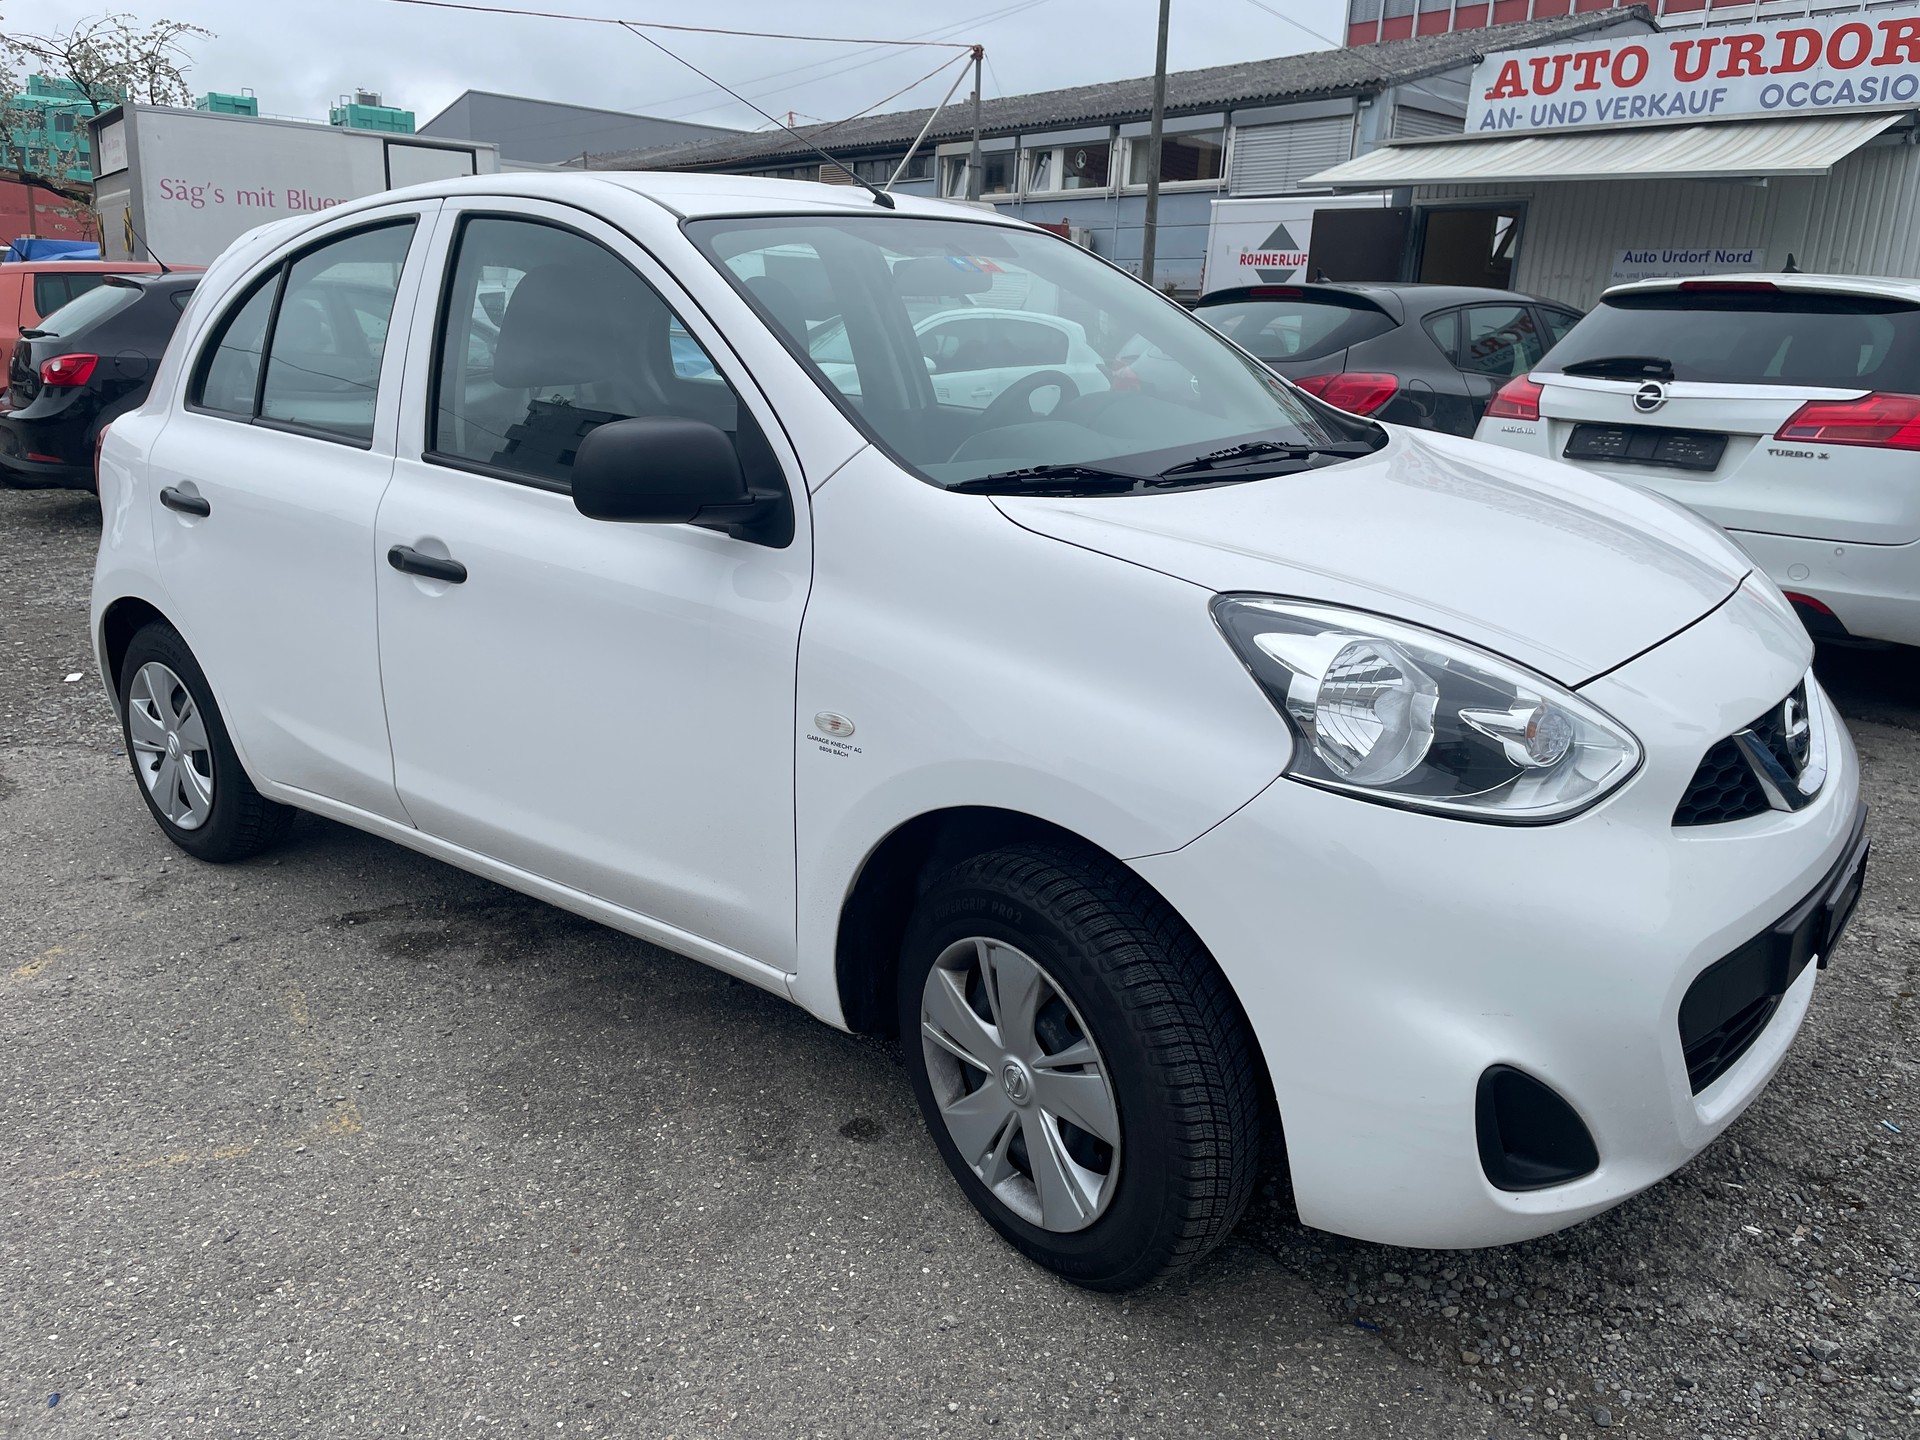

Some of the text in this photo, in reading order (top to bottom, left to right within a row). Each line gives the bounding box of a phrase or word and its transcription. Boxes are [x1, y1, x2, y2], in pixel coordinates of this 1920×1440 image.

[1484, 45, 1649, 100] AUTO
[1480, 107, 1523, 130] AN-
[1530, 101, 1587, 126] UND
[1596, 88, 1728, 120] VERKAUF
[236, 186, 276, 208] mit
[1622, 250, 1753, 263] Auto Urdorf Nord
[1767, 448, 1831, 460] TURBO X
[807, 734, 829, 745] GARAGE
[830, 741, 853, 751] KNECHT
